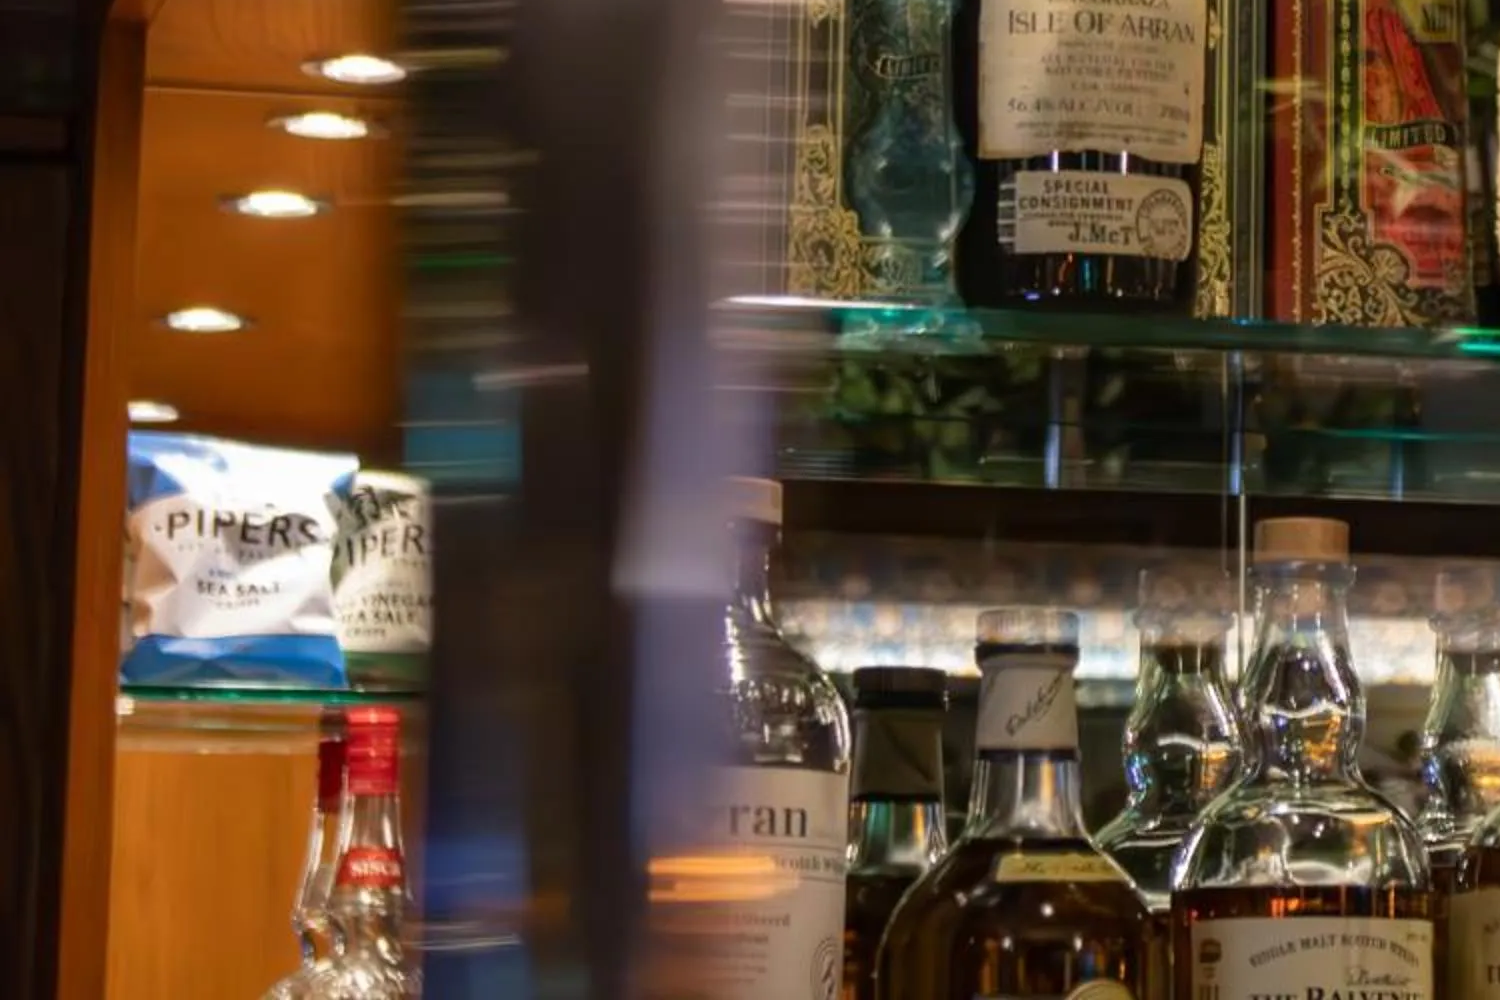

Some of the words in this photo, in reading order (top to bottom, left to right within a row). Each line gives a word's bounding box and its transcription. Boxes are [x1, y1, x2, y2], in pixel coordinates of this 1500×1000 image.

[1008, 9, 1066, 36] ISLE
[1073, 9, 1114, 35] OF
[1121, 16, 1197, 45] ARRAN
[1043, 178, 1111, 196] SPECIAL
[1018, 195, 1135, 213] CONSIGNMENT
[166, 508, 322, 549] PIPERS
[728, 803, 808, 838] ran
[1300, 934, 1337, 950] MALT
